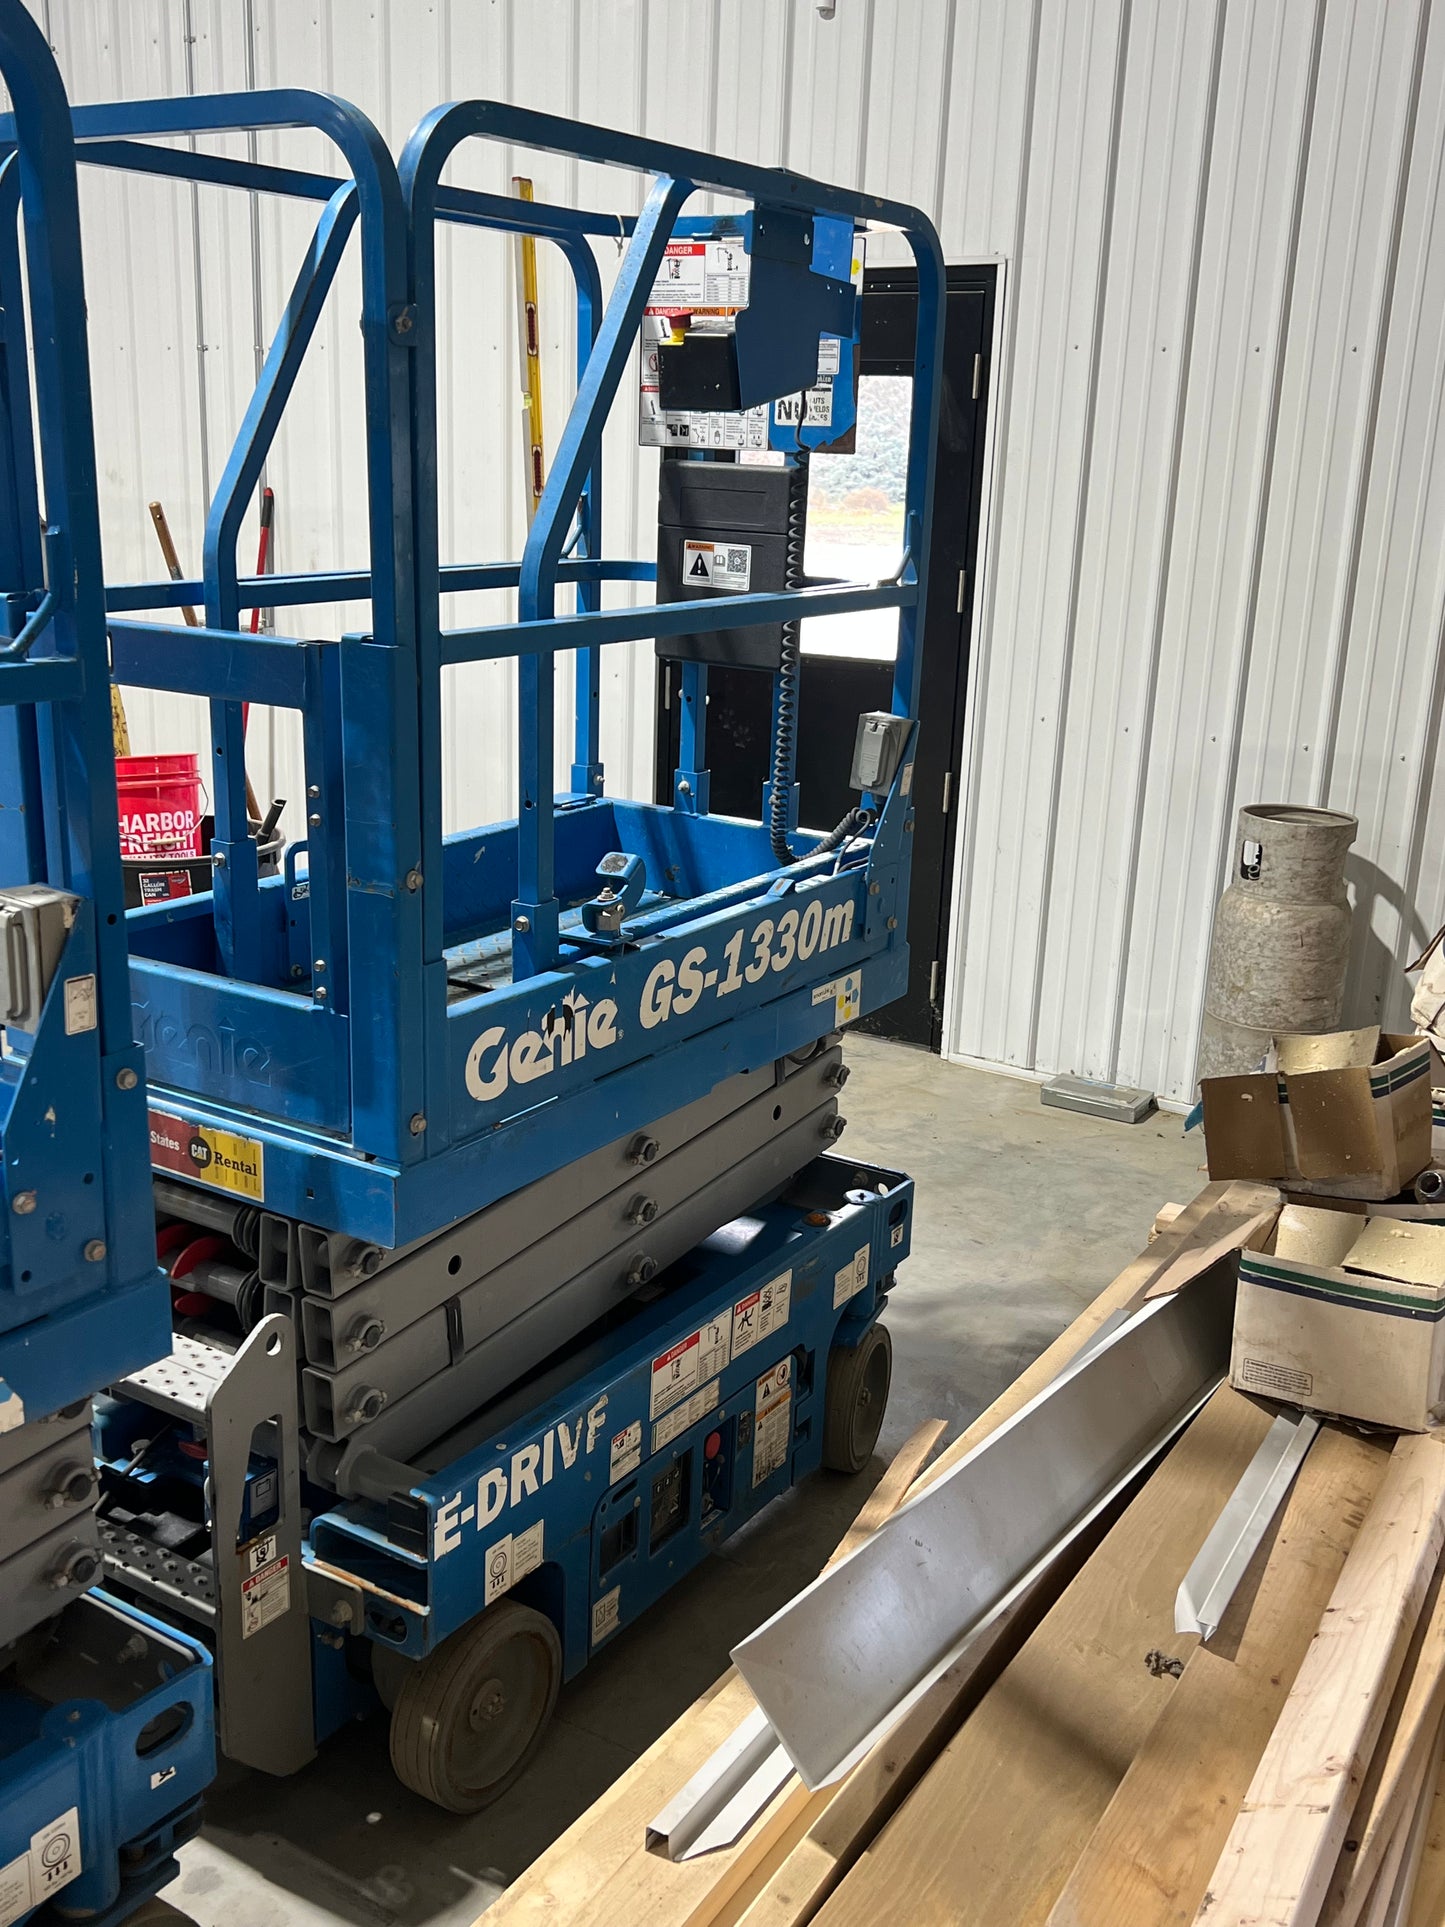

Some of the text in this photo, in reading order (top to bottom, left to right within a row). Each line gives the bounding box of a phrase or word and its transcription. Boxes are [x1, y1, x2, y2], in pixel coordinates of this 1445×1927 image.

[664, 246, 693, 255] DANGER
[119, 810, 194, 834] HARBOR
[119, 829, 196, 853] FREIGHT
[639, 898, 856, 1030] GS-1330m
[150, 1130, 181, 1151] States
[190, 1143, 208, 1161] CAT
[213, 1151, 258, 1177] Rental
[256, 1561, 282, 1583] DANGER
